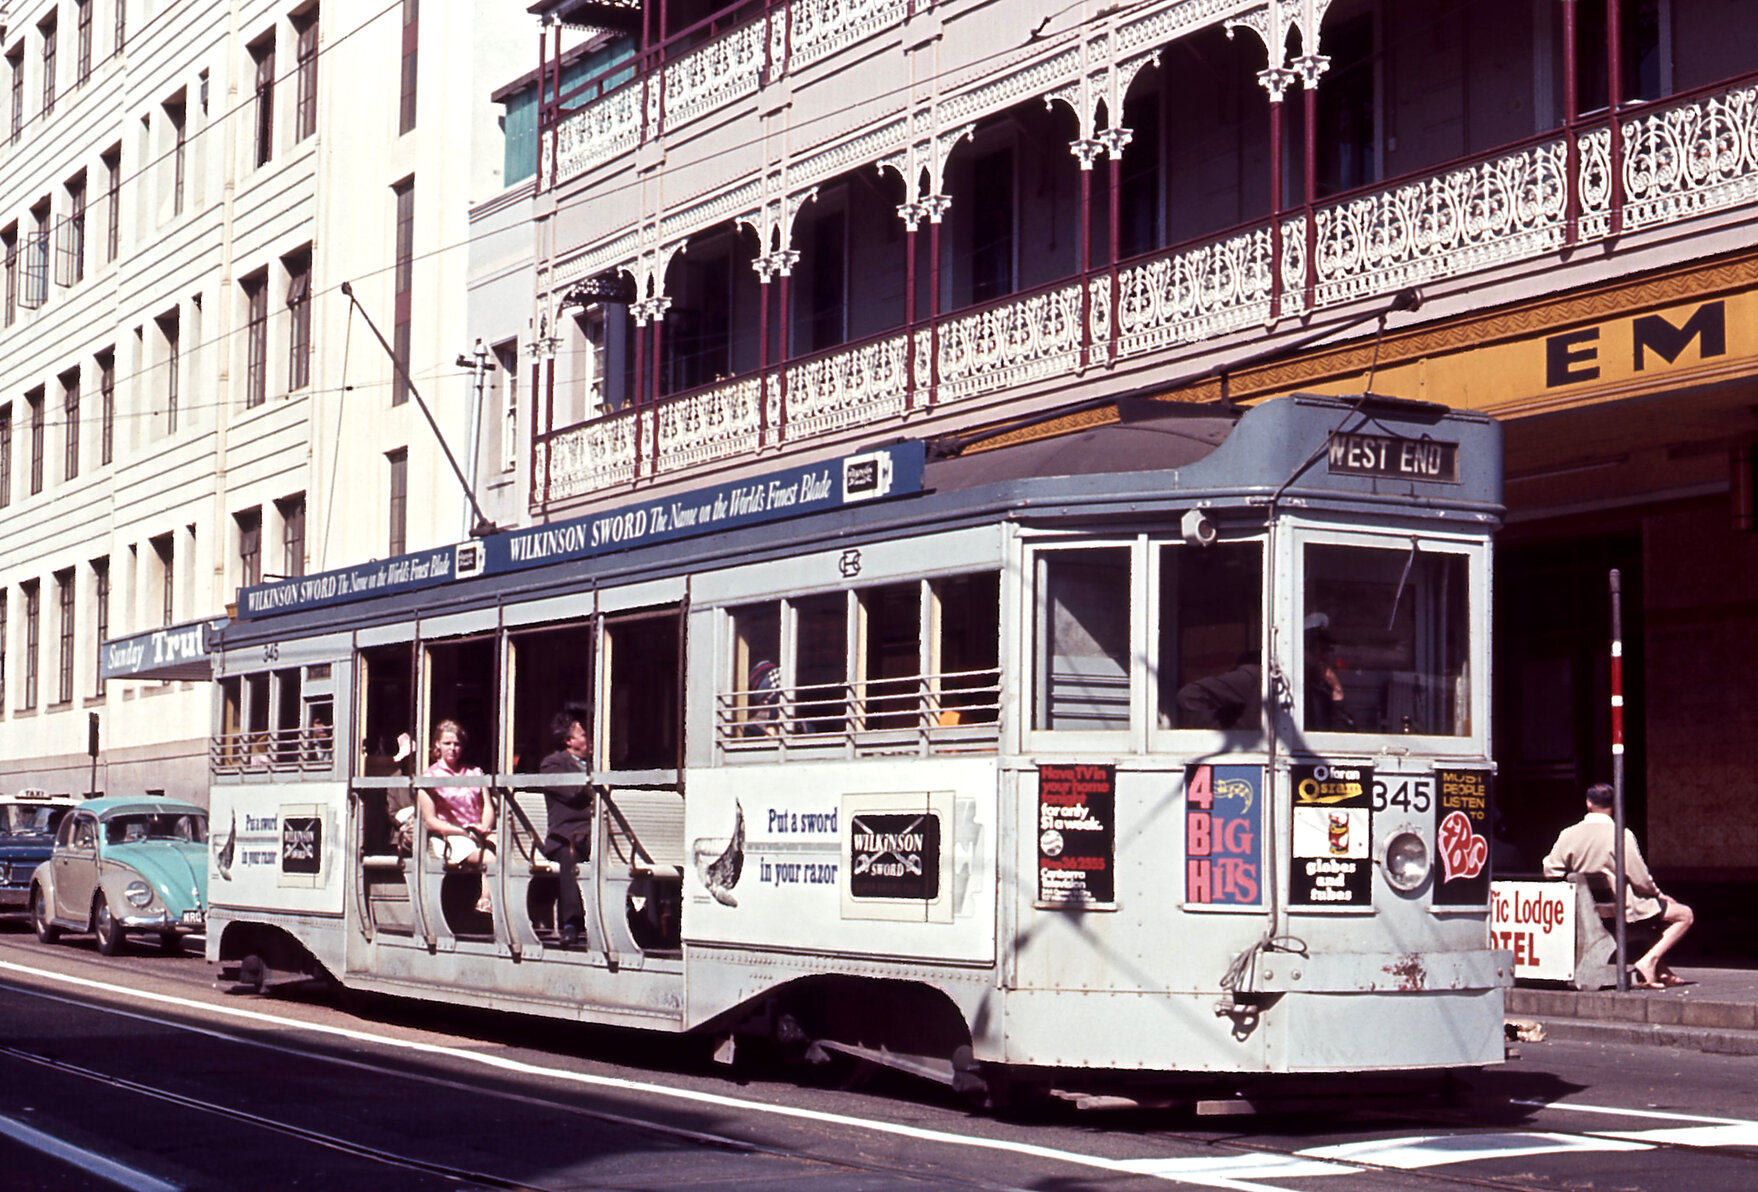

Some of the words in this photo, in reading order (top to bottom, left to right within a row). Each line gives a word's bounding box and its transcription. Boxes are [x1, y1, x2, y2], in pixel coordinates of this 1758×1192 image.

[1546, 300, 1726, 388] EM
[1329, 435, 1391, 469] WEST
[1401, 441, 1441, 475] END
[510, 524, 587, 562] WILKINSON
[591, 510, 647, 547] SWORD
[650, 506, 668, 534] The
[667, 502, 698, 530] Name
[699, 504, 711, 524] on
[712, 493, 728, 520] the
[766, 481, 798, 510] Finest
[799, 470, 832, 503] Blade
[248, 582, 300, 612] WILKINSON
[300, 575, 336, 603] SWORD
[338, 573, 350, 595] The
[108, 642, 144, 672] Sunday
[263, 643, 279, 663] 345
[1041, 766, 1075, 779] Have
[1075, 766, 1093, 779] TV
[1094, 766, 1106, 779] in
[1330, 766, 1345, 779] for
[1042, 782, 1071, 794] your
[1072, 780, 1110, 792] home
[1188, 765, 1213, 809] 4
[1298, 778, 1363, 802] Osram
[1373, 780, 1431, 812] 345
[1443, 783, 1485, 796] PEOPLE
[1041, 802, 1060, 816] for
[1060, 803, 1089, 820] only
[1443, 796, 1485, 808] LISTEN
[768, 809, 789, 833] Put
[791, 813, 798, 833] a
[801, 807, 838, 833] sword
[1055, 819, 1063, 830] a
[1470, 811, 1485, 820] TO
[1187, 811, 1254, 856] BIG
[760, 857, 772, 882] in
[775, 862, 802, 887] your
[804, 863, 838, 884] razor
[871, 863, 905, 877] SWORD
[1305, 859, 1356, 876] globes
[1188, 858, 1258, 903] HITS
[1316, 872, 1345, 887] and
[1310, 886, 1352, 901] tubes
[1515, 890, 1564, 934] Lodge
